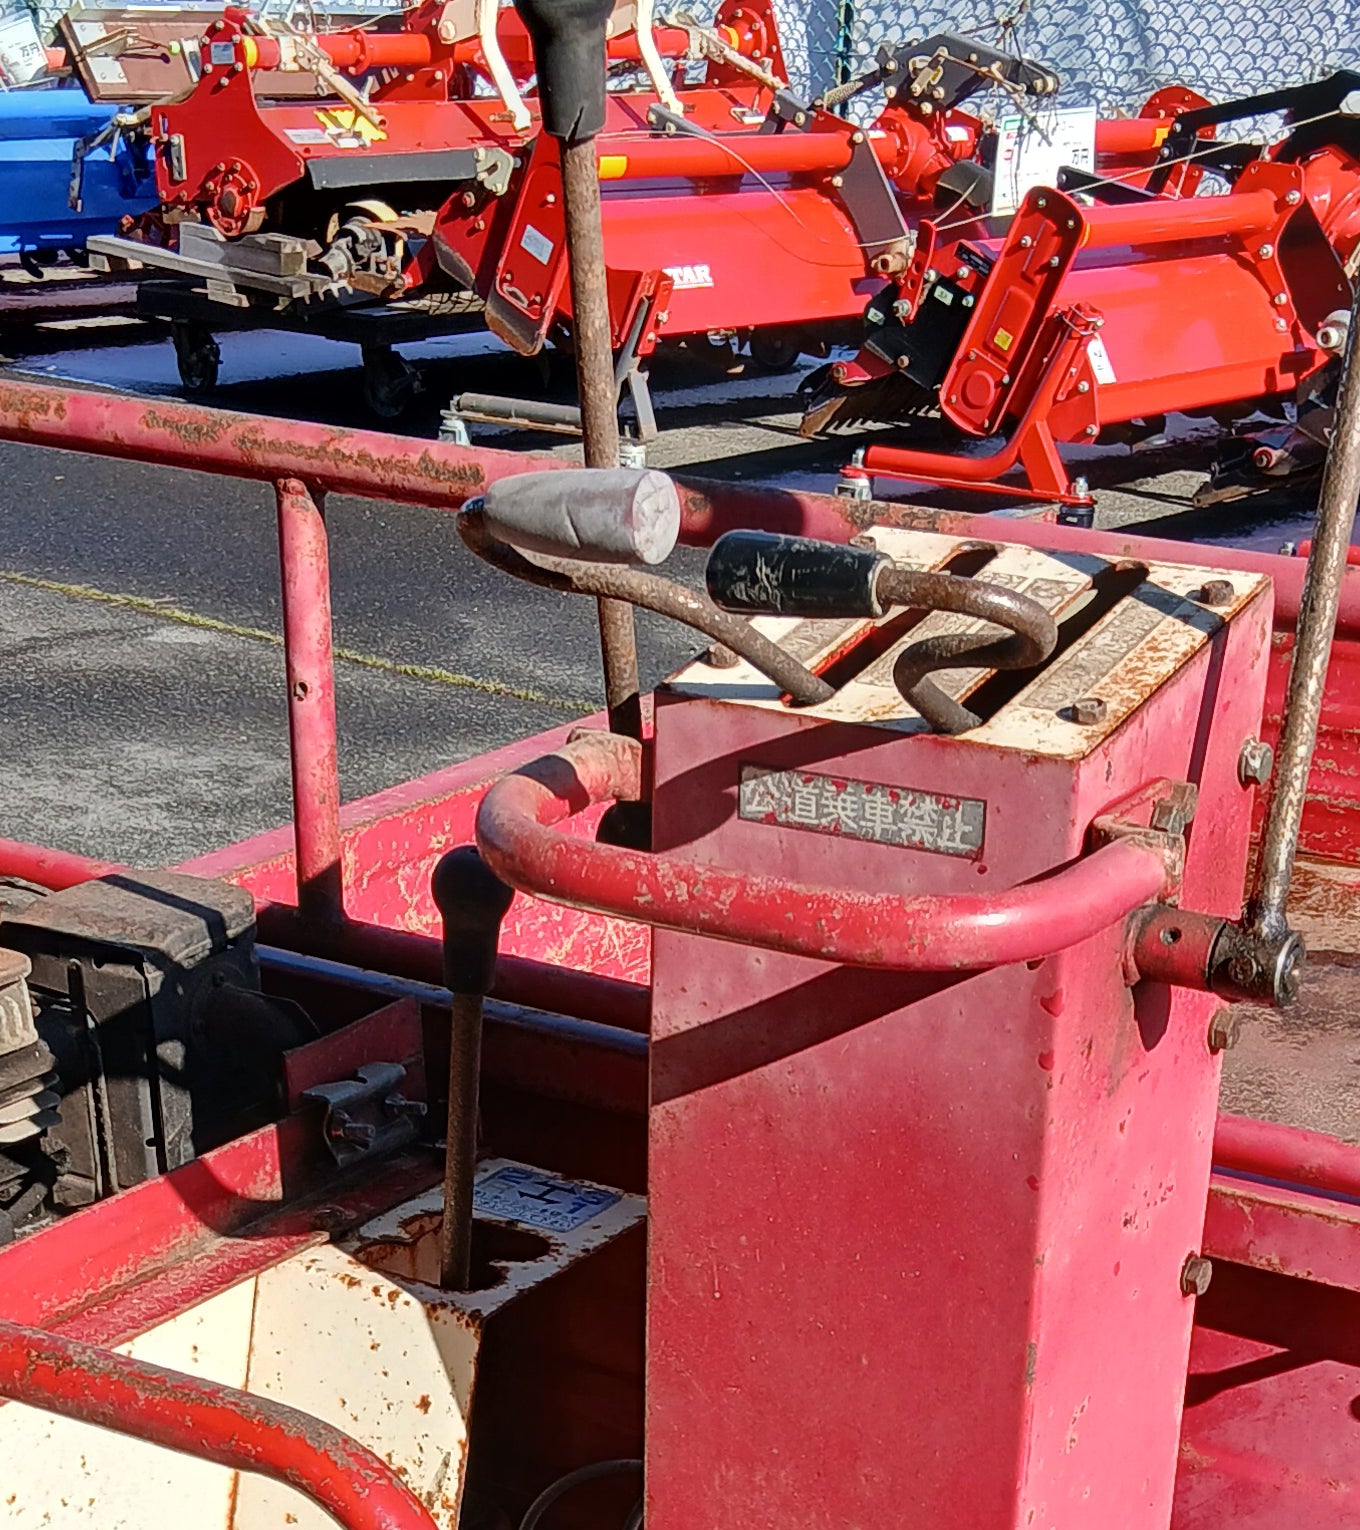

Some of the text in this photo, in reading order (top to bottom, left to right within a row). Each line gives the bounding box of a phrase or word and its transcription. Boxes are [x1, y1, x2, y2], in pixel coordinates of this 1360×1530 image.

[661, 263, 714, 286] TAR
[740, 769, 974, 851] 公道乗車禁止
